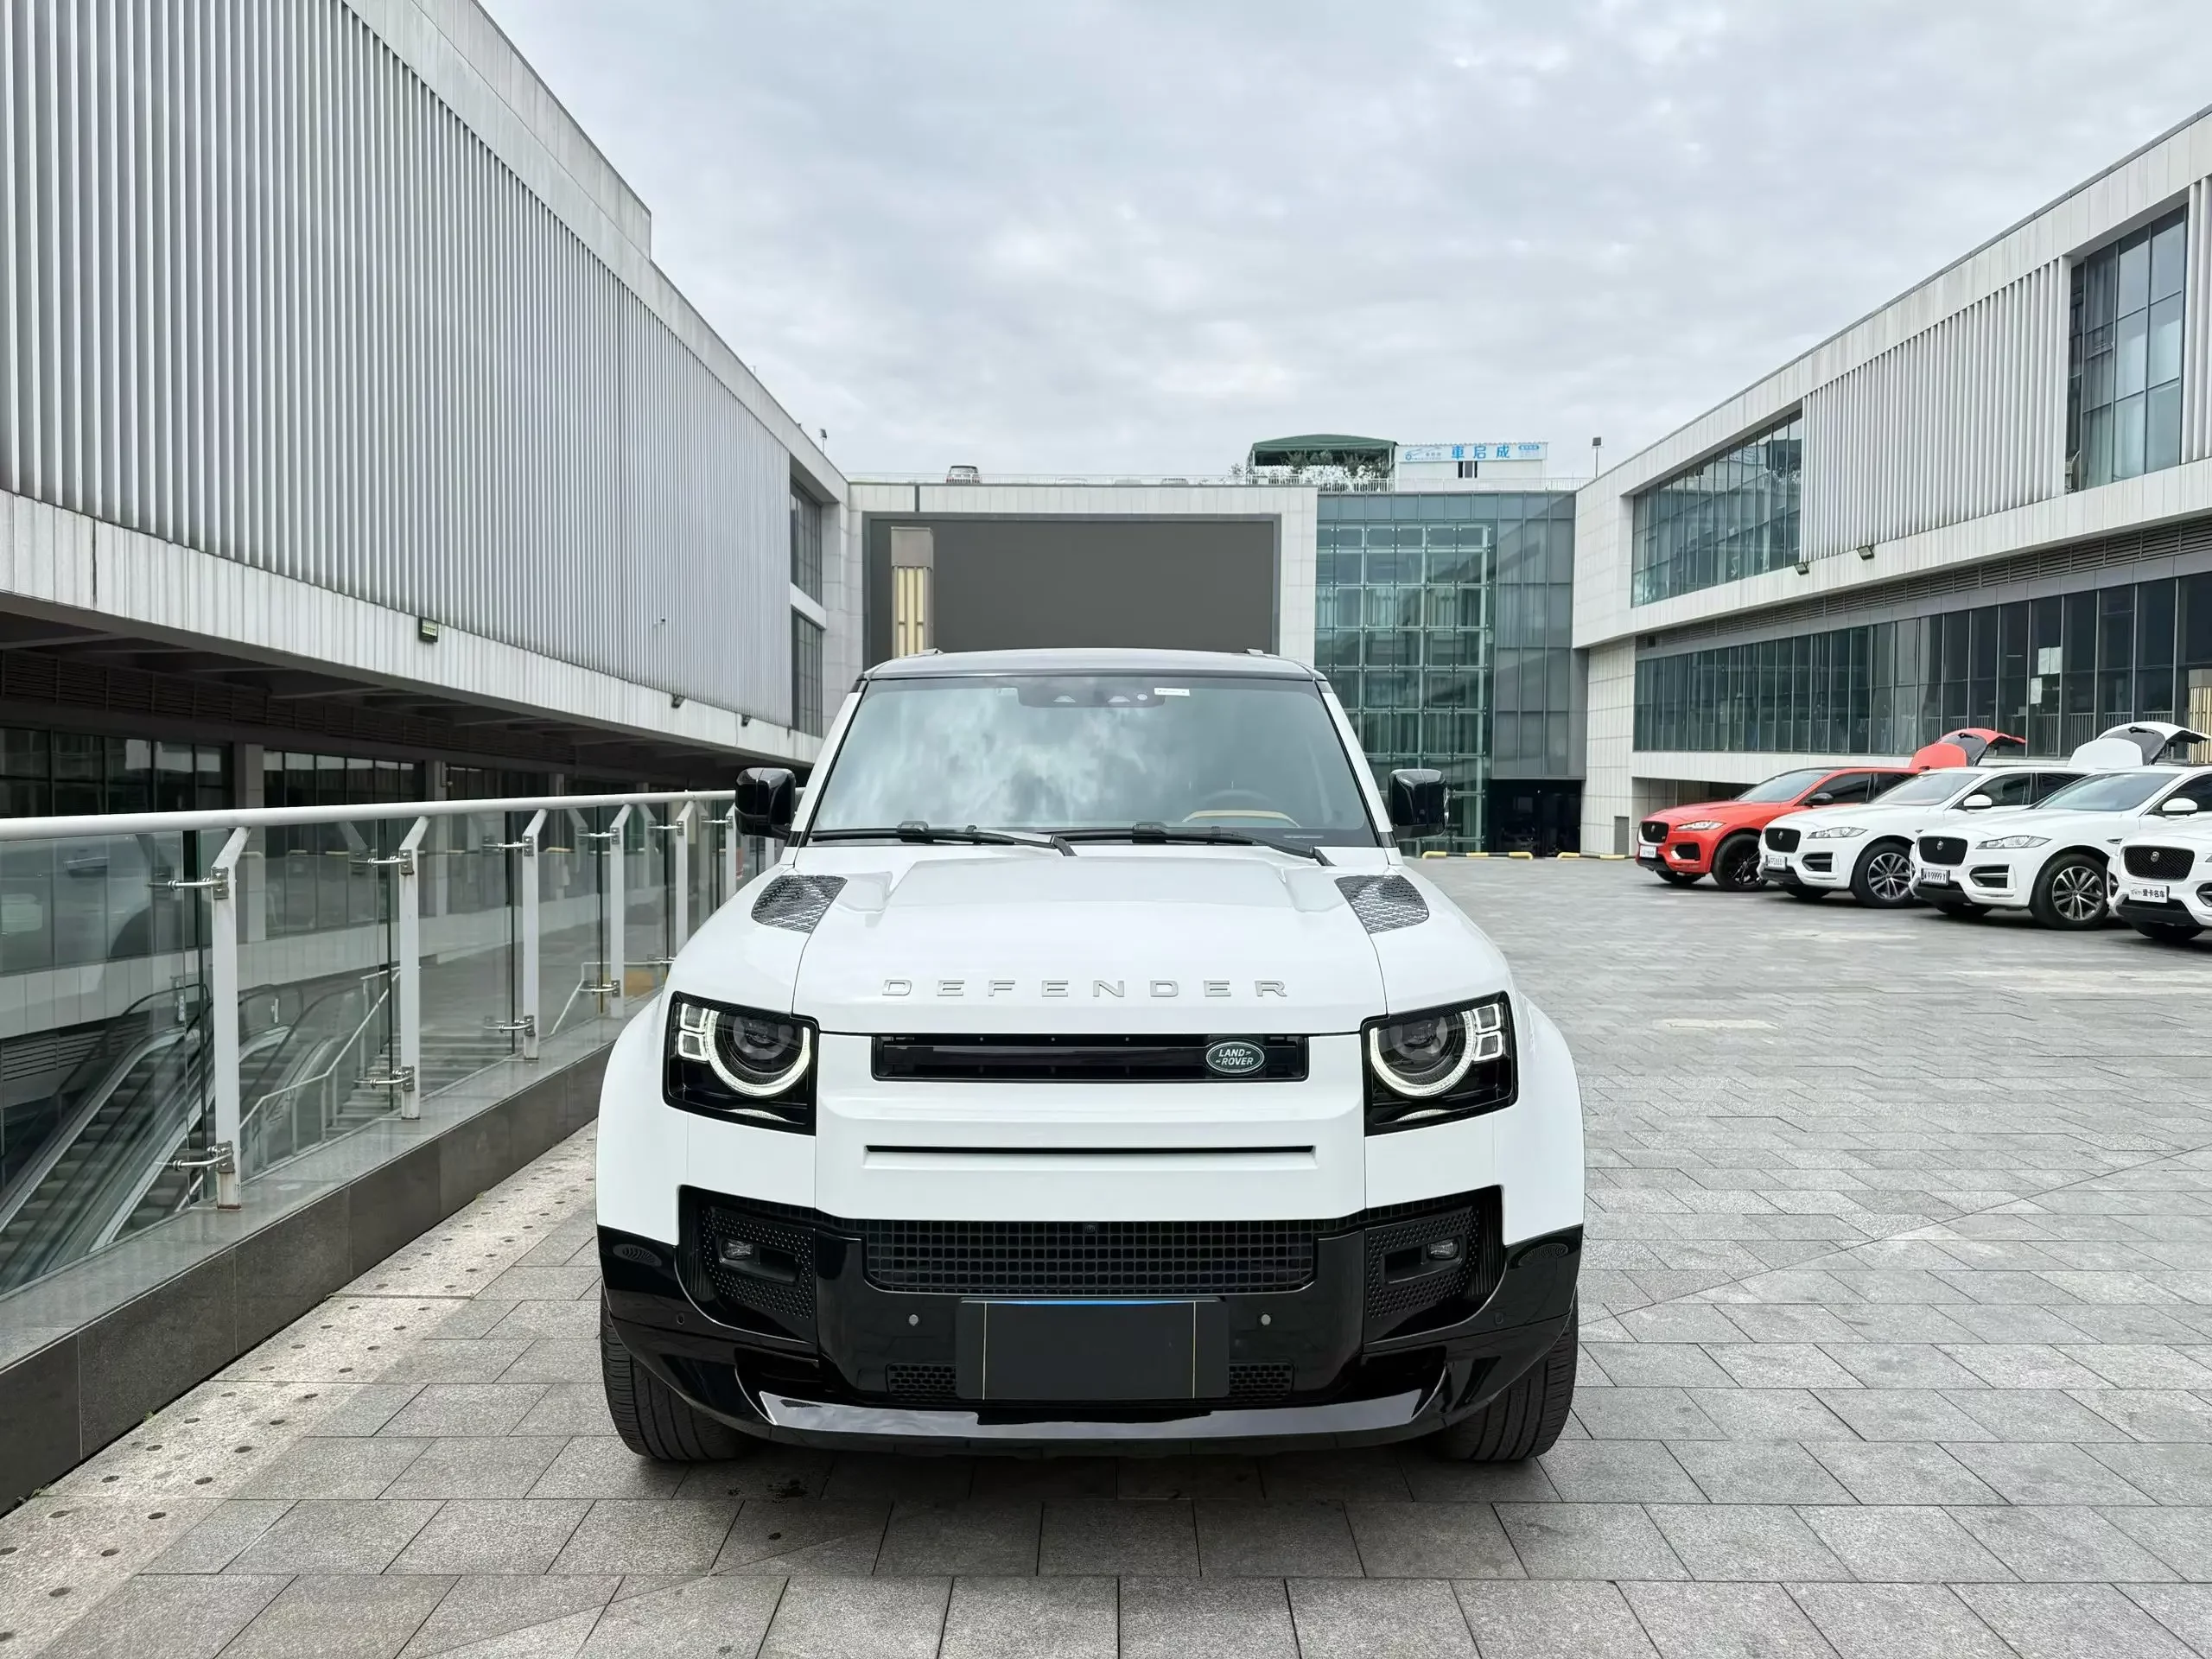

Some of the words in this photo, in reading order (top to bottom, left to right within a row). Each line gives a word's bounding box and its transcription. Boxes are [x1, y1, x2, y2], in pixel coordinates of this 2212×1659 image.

[881, 979, 1288, 998] DEFENDER
[1218, 1048, 1245, 1058] LAND
[1221, 1057, 1254, 1065] ROVER
